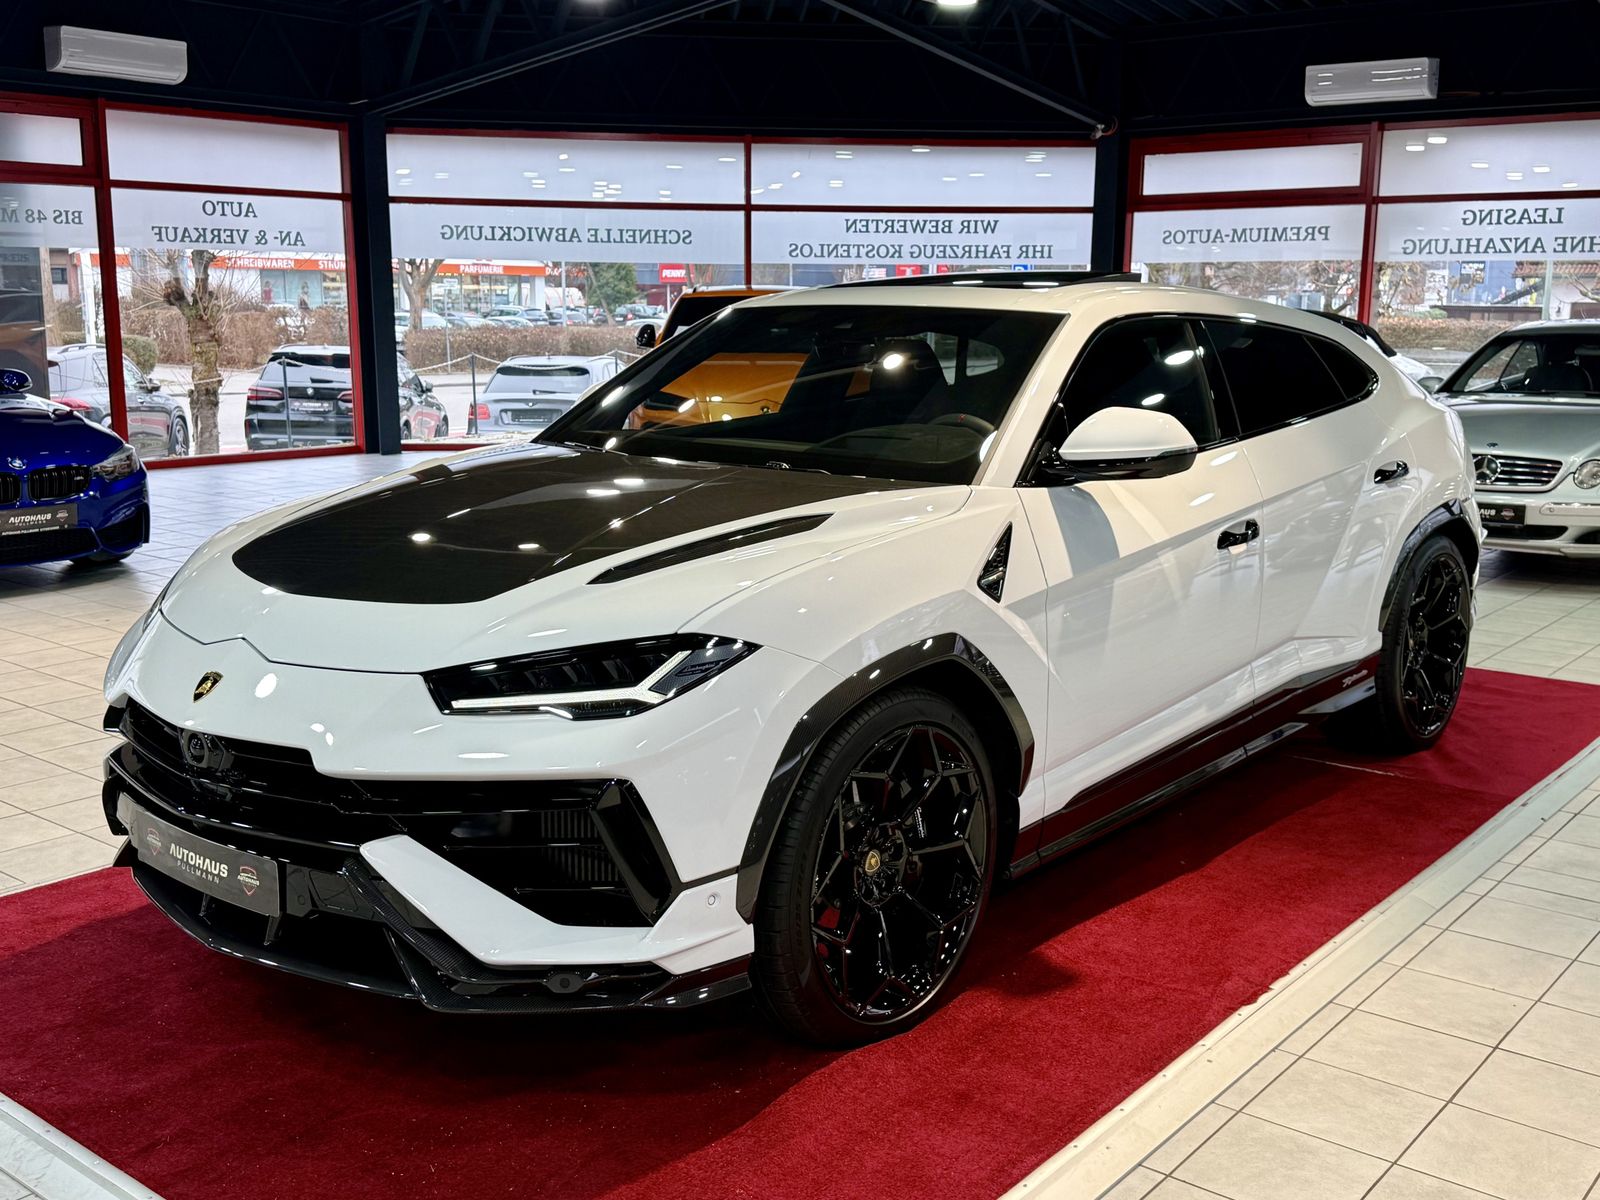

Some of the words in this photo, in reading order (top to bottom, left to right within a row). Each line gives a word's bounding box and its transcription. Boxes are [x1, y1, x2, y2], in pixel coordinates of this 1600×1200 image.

[8, 513, 52, 524] AUTOHAUS
[169, 842, 229, 878] AUTOHAUS
[177, 860, 220, 884] PULLMANN
